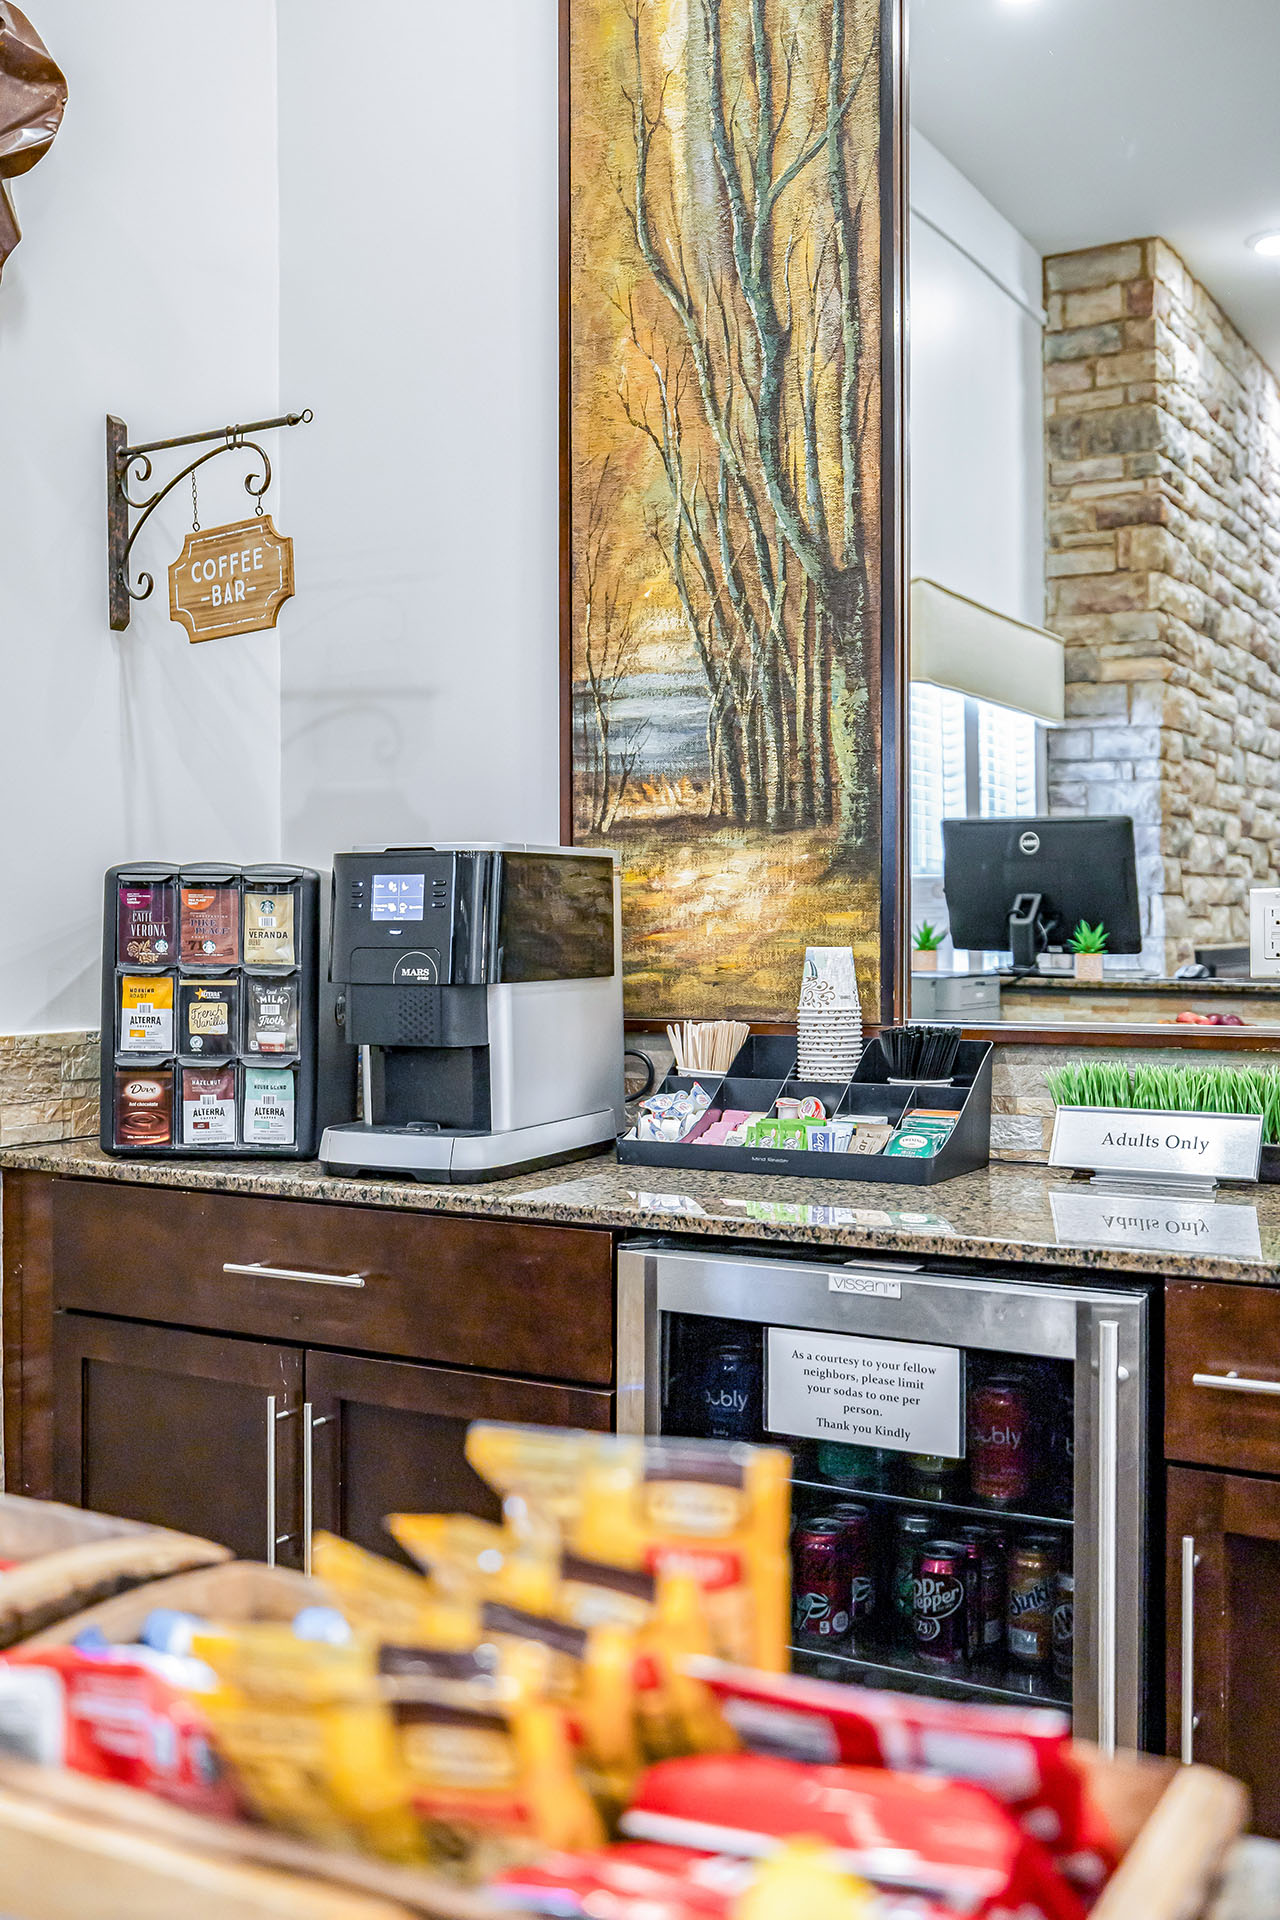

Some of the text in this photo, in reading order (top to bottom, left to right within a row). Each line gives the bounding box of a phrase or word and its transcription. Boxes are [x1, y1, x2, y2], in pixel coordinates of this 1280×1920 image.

[191, 547, 263, 583] COFFEE
[131, 924, 167, 937] VERONA
[248, 931, 288, 939] VERANDA
[401, 968, 430, 976] MARS
[259, 995, 285, 1005] MILK
[191, 1004, 223, 1020] French
[130, 1015, 162, 1025] ALTERRA
[193, 1015, 226, 1028] Vanilla
[257, 1015, 286, 1027] Froth
[130, 1083, 157, 1095] Dove
[192, 1107, 226, 1118] ALTERRA
[254, 1107, 285, 1117] ALTERRA
[1101, 1132, 1210, 1155] Adults Only
[792, 1350, 804, 1360] As
[815, 1353, 860, 1368] courtesy
[862, 1359, 873, 1368] to
[875, 1361, 901, 1371] your
[903, 1362, 937, 1375] fellow
[803, 1368, 924, 1390] neighbors, please limit
[807, 1384, 921, 1406] your sodas to one per
[843, 1405, 883, 1417] person.
[816, 1416, 911, 1441] Thank you Kindly
